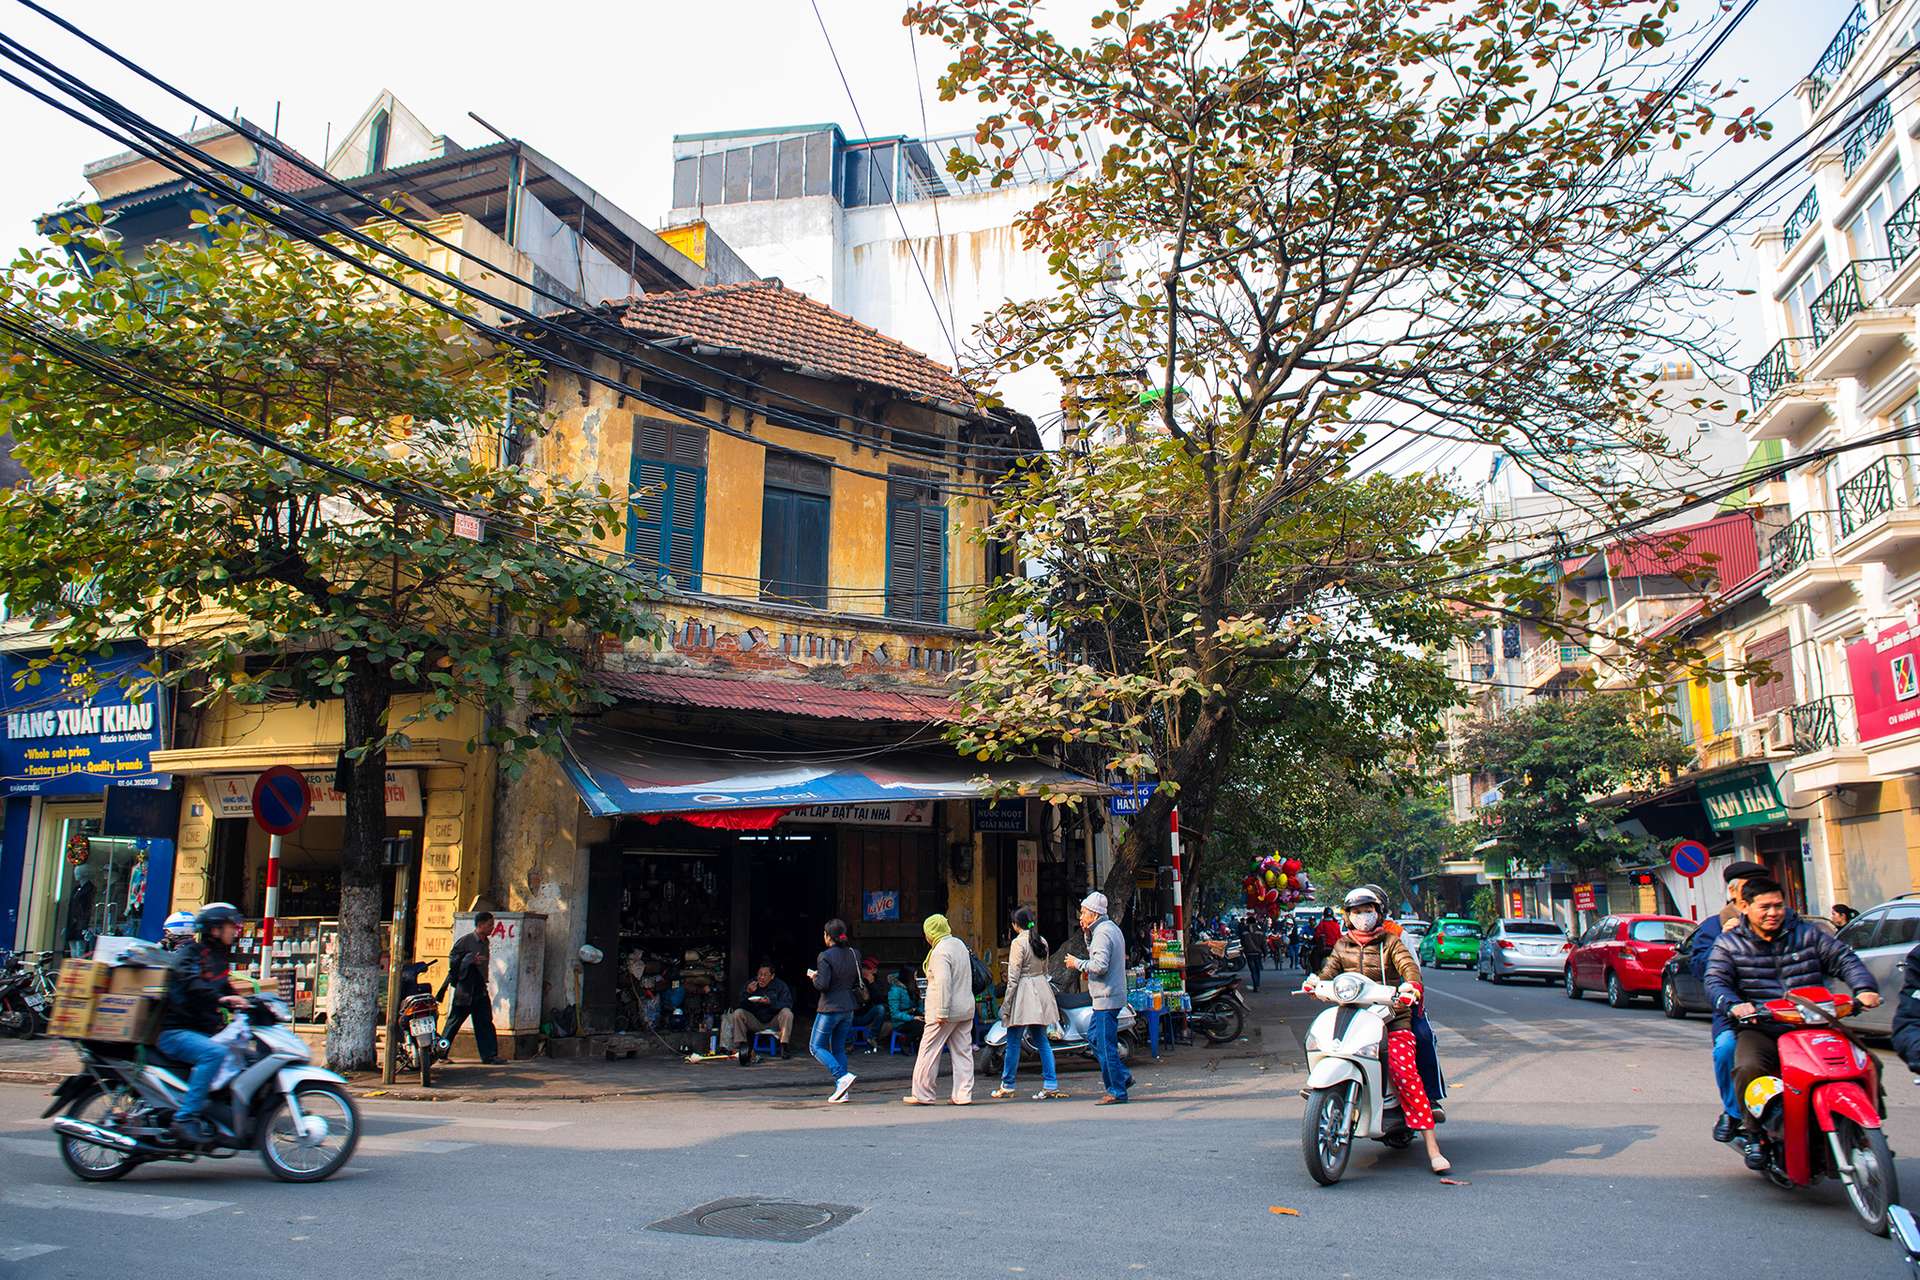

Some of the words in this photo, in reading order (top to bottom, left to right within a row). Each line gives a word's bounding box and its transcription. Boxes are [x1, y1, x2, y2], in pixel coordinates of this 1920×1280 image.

[57, 698, 102, 736] XUẤT
[100, 734, 118, 744] Made
[28, 748, 50, 760] Whole
[52, 747, 67, 758] sale
[68, 746, 90, 761] prices
[29, 764, 56, 778] Factory
[57, 763, 69, 774] out
[71, 762, 81, 773] let
[87, 760, 115, 774] Quality
[117, 758, 143, 772] brands
[1706, 791, 1743, 820] NAM
